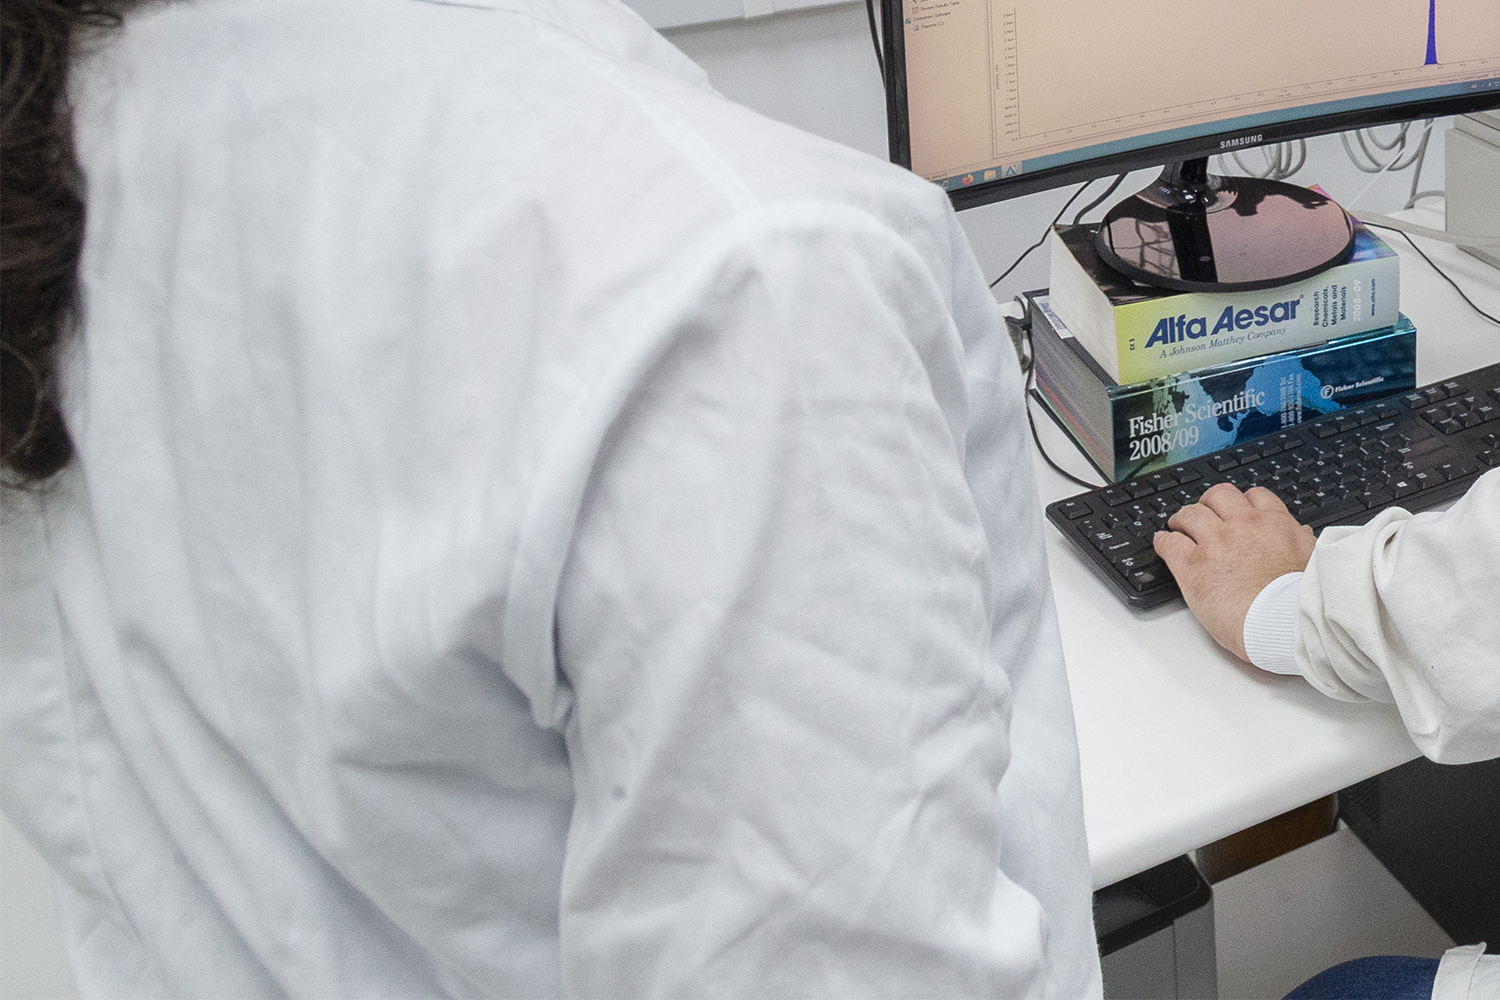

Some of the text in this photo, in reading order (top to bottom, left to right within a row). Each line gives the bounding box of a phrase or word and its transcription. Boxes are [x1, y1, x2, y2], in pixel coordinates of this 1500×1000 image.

[1220, 134, 1263, 149] SAMSUNG
[1353, 279, 1362, 322] 2008-09
[1144, 298, 1301, 349] Alfa Aesar
[1159, 325, 1287, 359] A Johnson Matthey Company
[1335, 383, 1354, 393] Fisher
[1355, 377, 1384, 389] Scientific
[1129, 389, 1266, 439] Fisher Scientific
[1129, 426, 1200, 462] 2008/09
